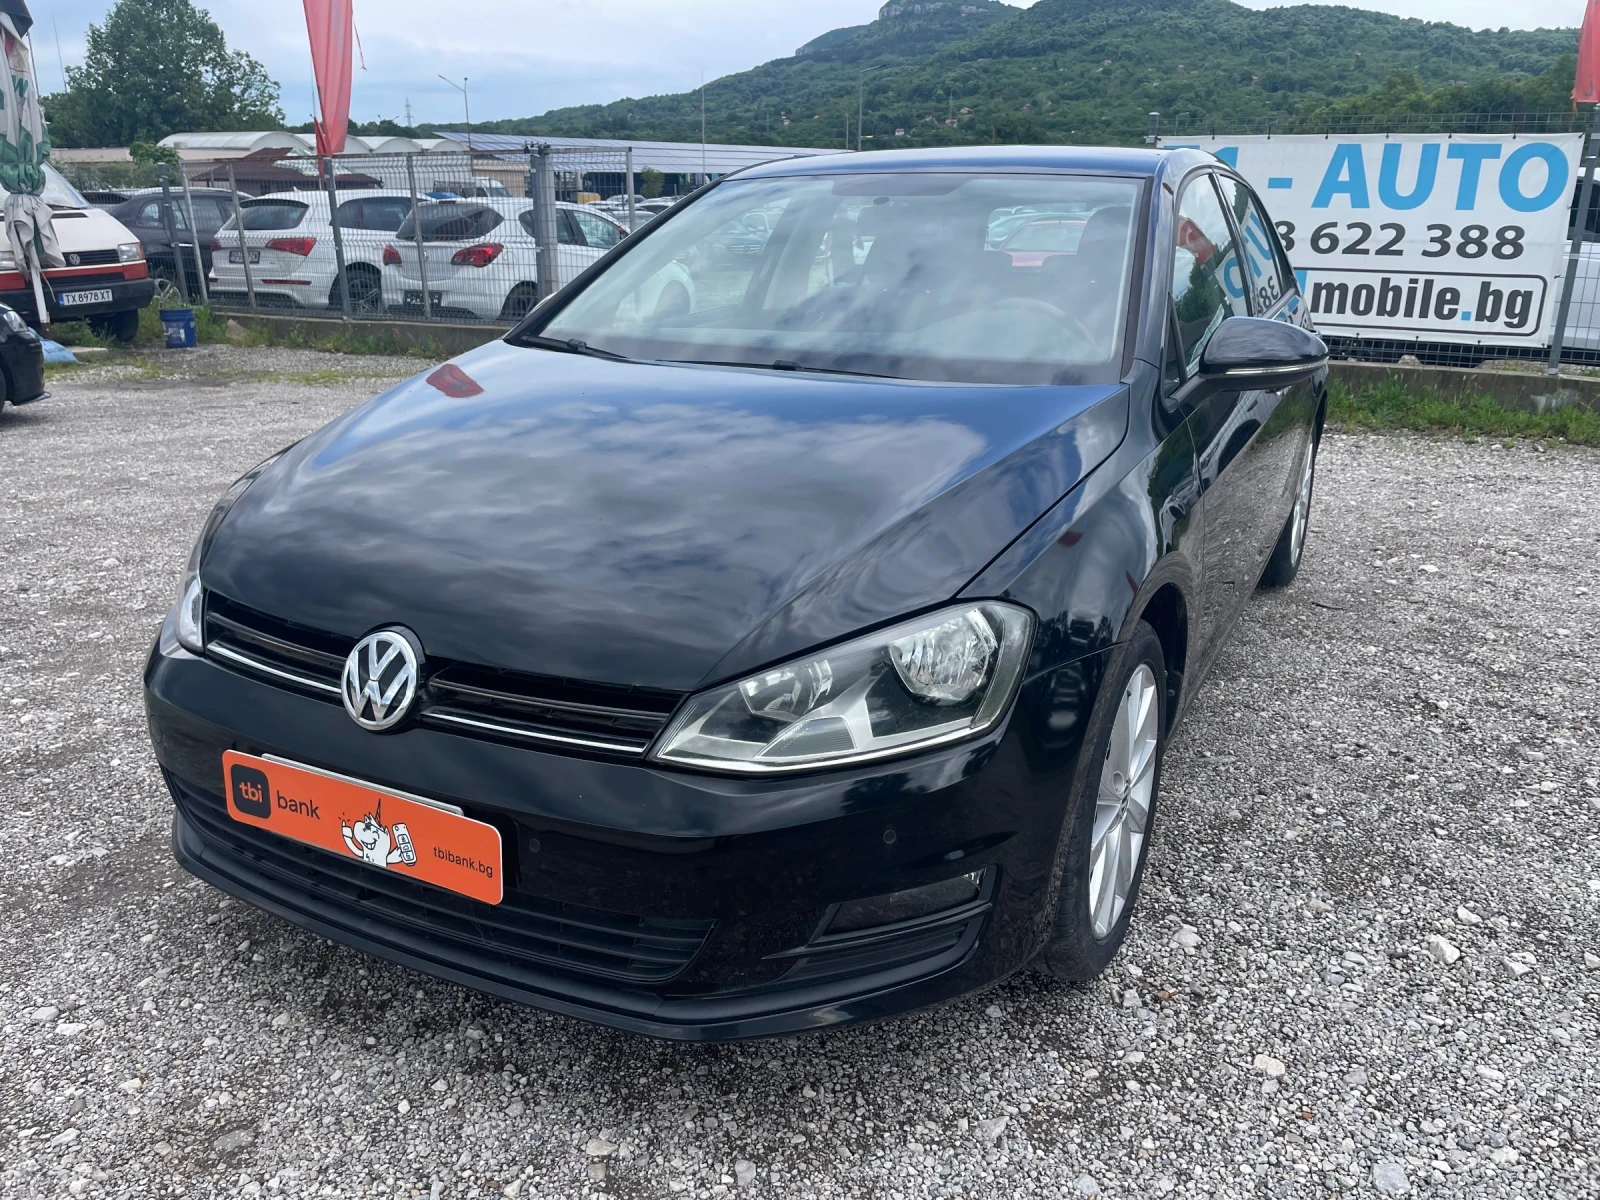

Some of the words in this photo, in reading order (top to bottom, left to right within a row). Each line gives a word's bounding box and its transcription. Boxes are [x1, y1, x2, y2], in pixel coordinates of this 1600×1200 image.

[1311, 142, 1570, 212] AUTO
[1309, 221, 1406, 255] 622
[1421, 223, 1525, 260] 388
[65, 294, 77, 304] TX
[78, 292, 99, 303] 8978
[100, 290, 110, 300] XT
[1310, 276, 1533, 329] mobile.bg
[239, 781, 263, 803] tbi
[276, 789, 321, 820] bank
[433, 846, 493, 878] tbibank.bg
